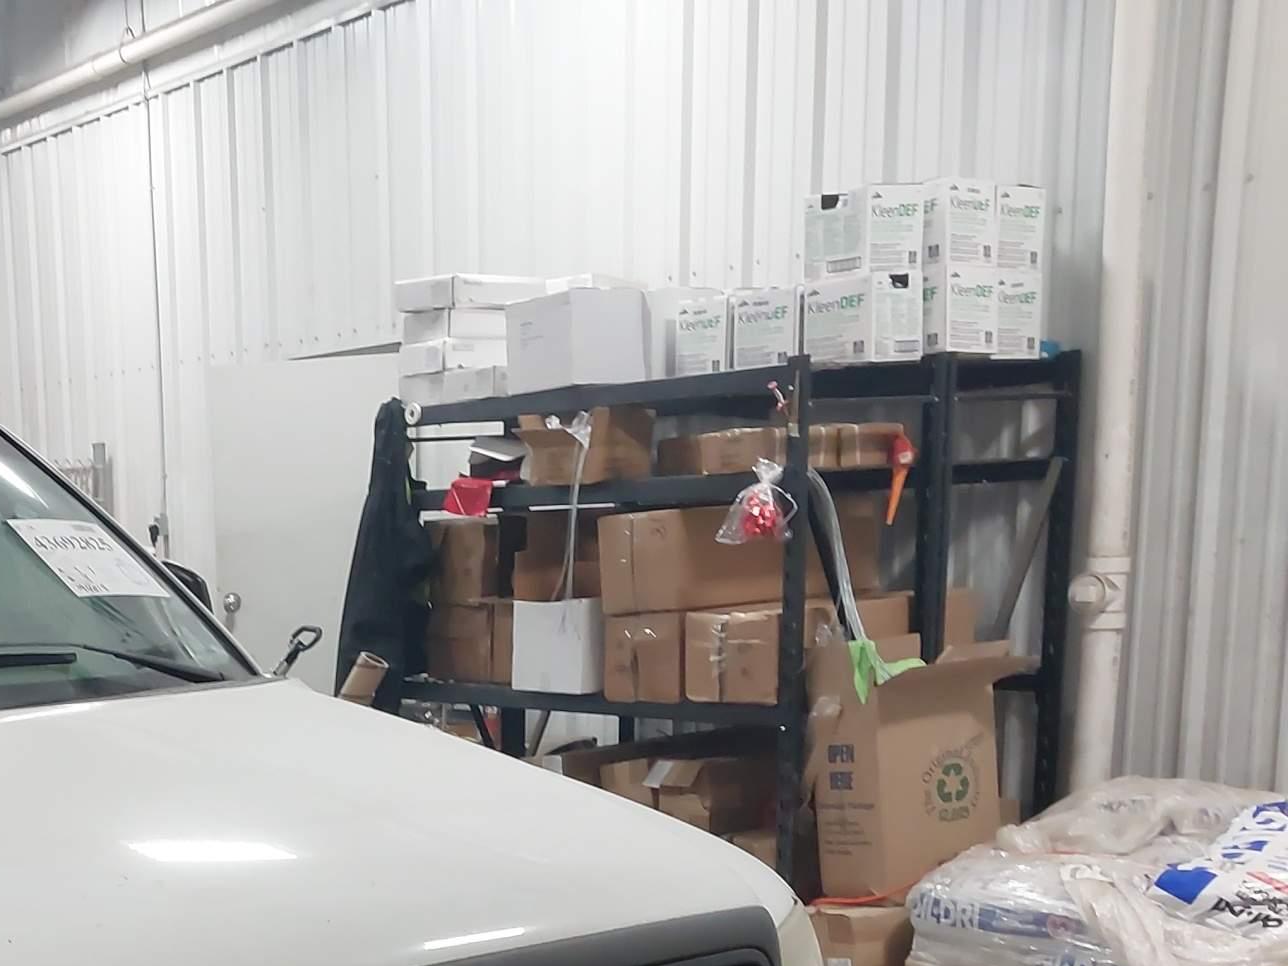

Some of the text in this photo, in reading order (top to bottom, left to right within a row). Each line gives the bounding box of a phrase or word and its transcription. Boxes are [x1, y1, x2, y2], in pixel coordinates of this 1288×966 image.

[871, 203, 919, 218] KleenDEF
[1000, 203, 1040, 217] KleenDEF
[951, 284, 993, 297] KleenDEF
[807, 293, 864, 315] KleenDEF
